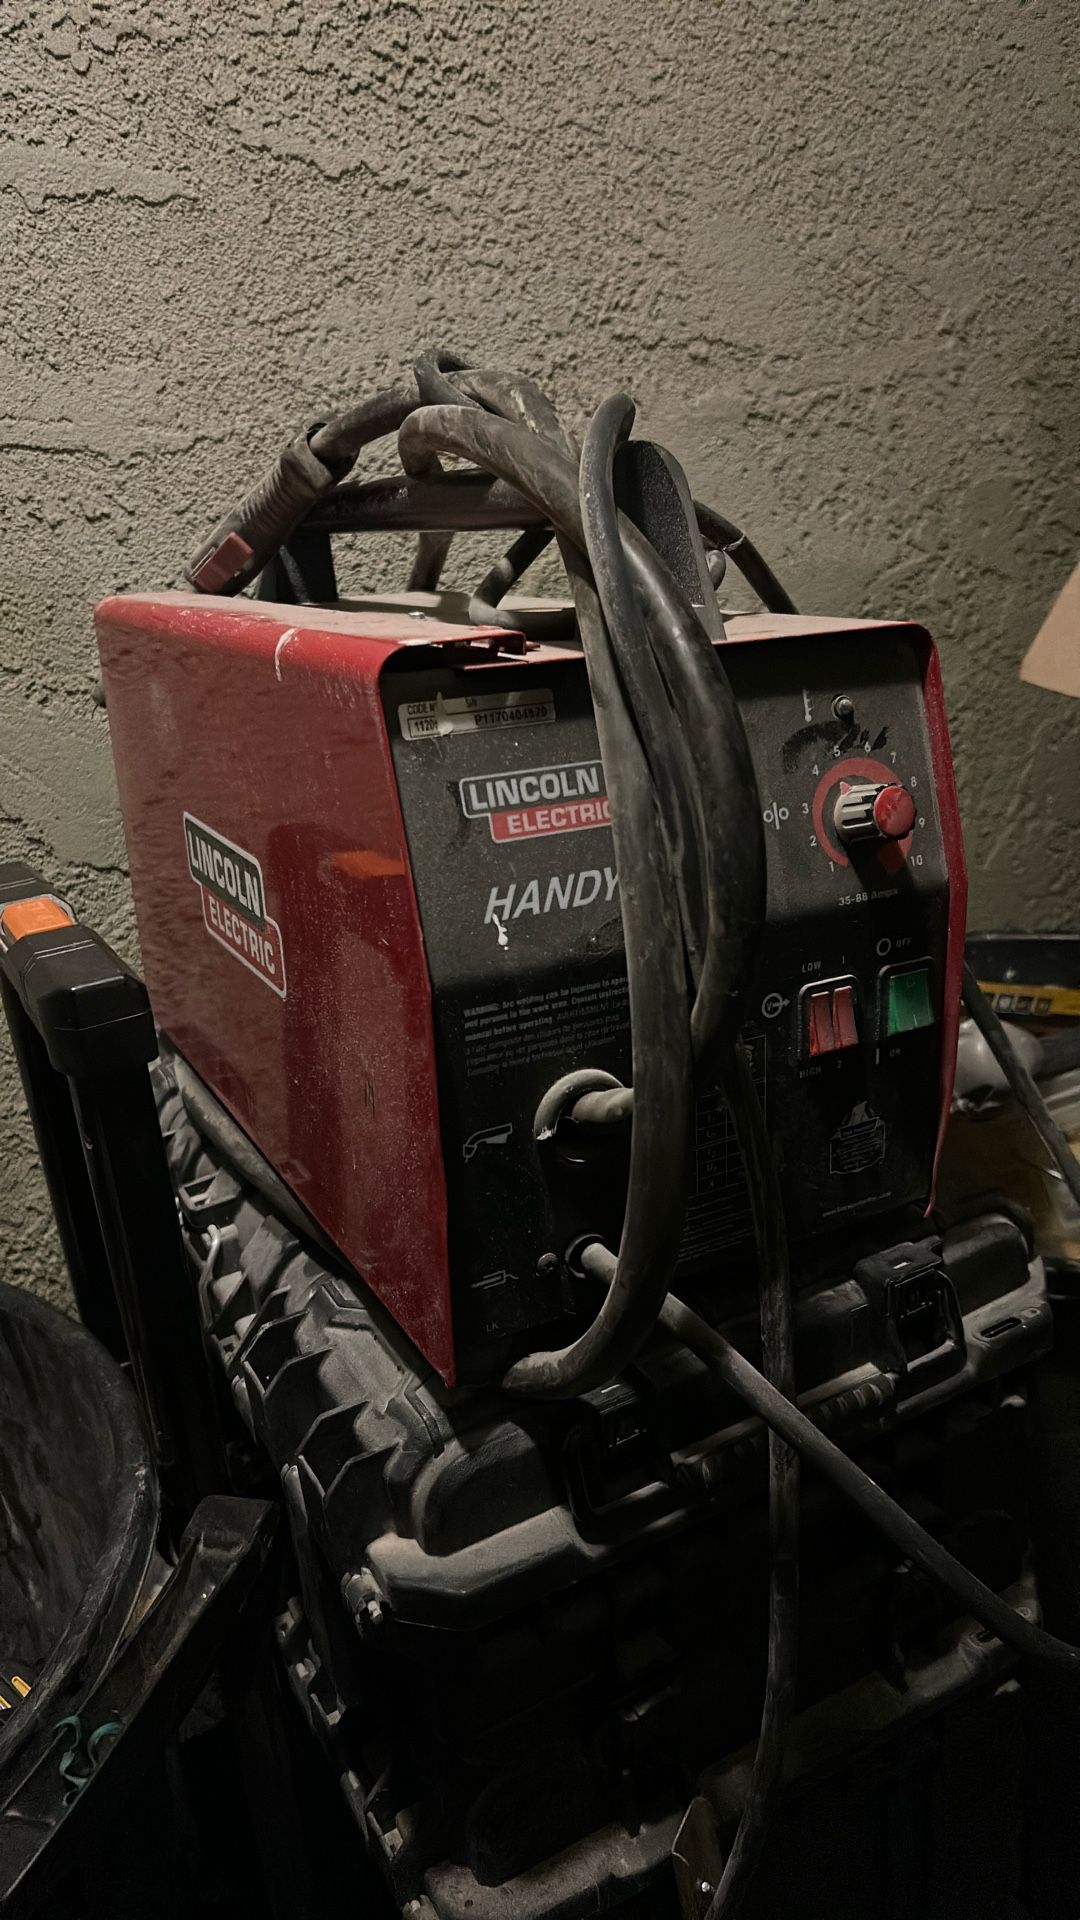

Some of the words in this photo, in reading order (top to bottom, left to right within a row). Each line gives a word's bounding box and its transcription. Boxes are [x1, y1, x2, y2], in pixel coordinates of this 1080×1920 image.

[407, 704, 428, 716] CODE
[833, 747, 841, 758] 5
[864, 742, 872, 753] 6
[890, 752, 897, 764] 7
[812, 764, 819, 776] 4
[910, 776, 917, 788] 8
[468, 767, 600, 811] LINCOLN
[801, 803, 809, 814] 3
[918, 818, 925, 828] 9
[809, 835, 817, 847] 2
[910, 855, 923, 866] 10
[828, 862, 834, 872] 1
[187, 830, 262, 918] LINCOLN
[483, 867, 620, 925] HANDY
[838, 891, 868, 906] 35-88
[207, 894, 276, 976] ELECTRIC
[895, 937, 912, 948] OFF
[801, 961, 822, 973] LOW
[799, 1066, 822, 1079] HIGH
